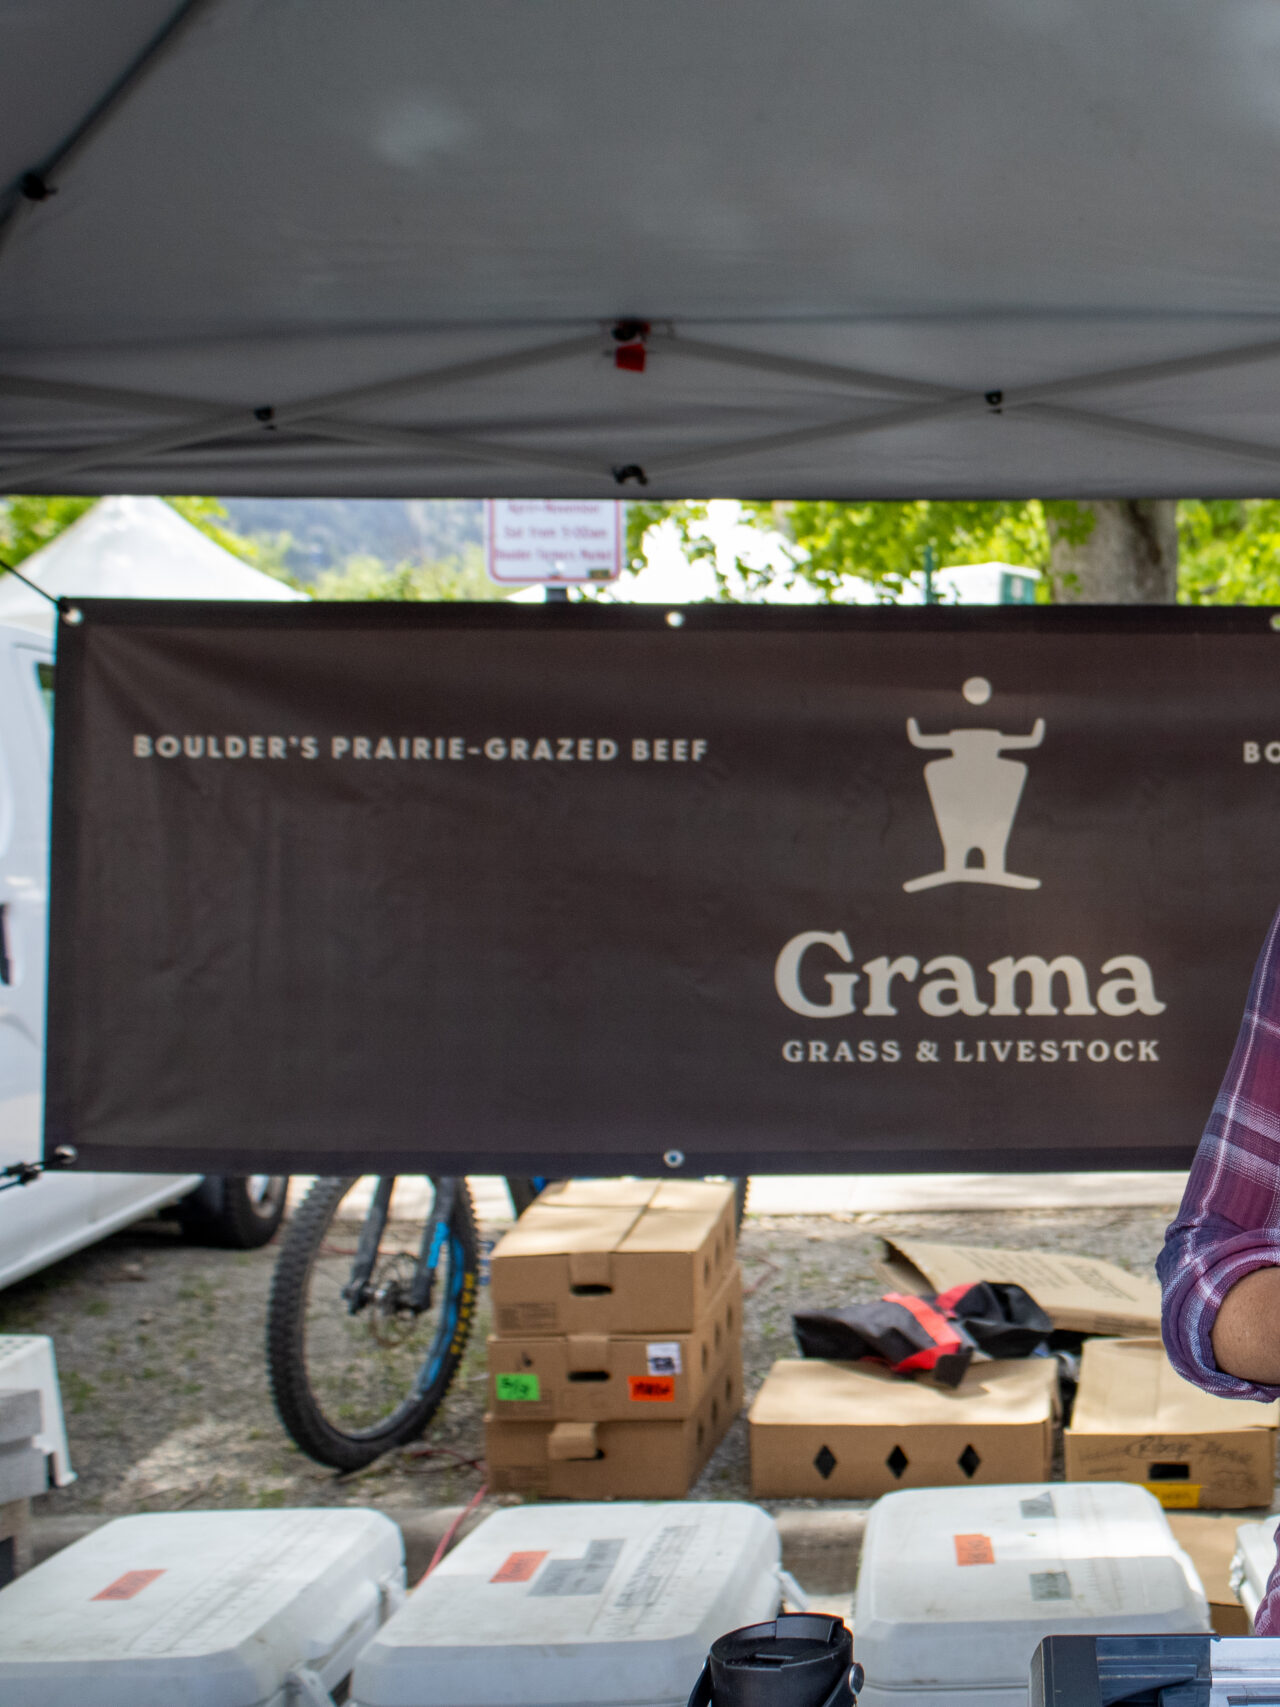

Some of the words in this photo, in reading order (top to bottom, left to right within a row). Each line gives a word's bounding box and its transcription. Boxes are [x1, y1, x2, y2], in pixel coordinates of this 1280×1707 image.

[132, 734, 319, 759] BOULDER'S
[330, 736, 618, 760] PRAIRIE-GRAZED
[631, 738, 707, 761] BEEF
[774, 930, 1167, 1018] Grama
[781, 1040, 901, 1063] GRASS
[915, 1040, 939, 1063] &
[954, 1039, 1160, 1063] LIVESTOCK
